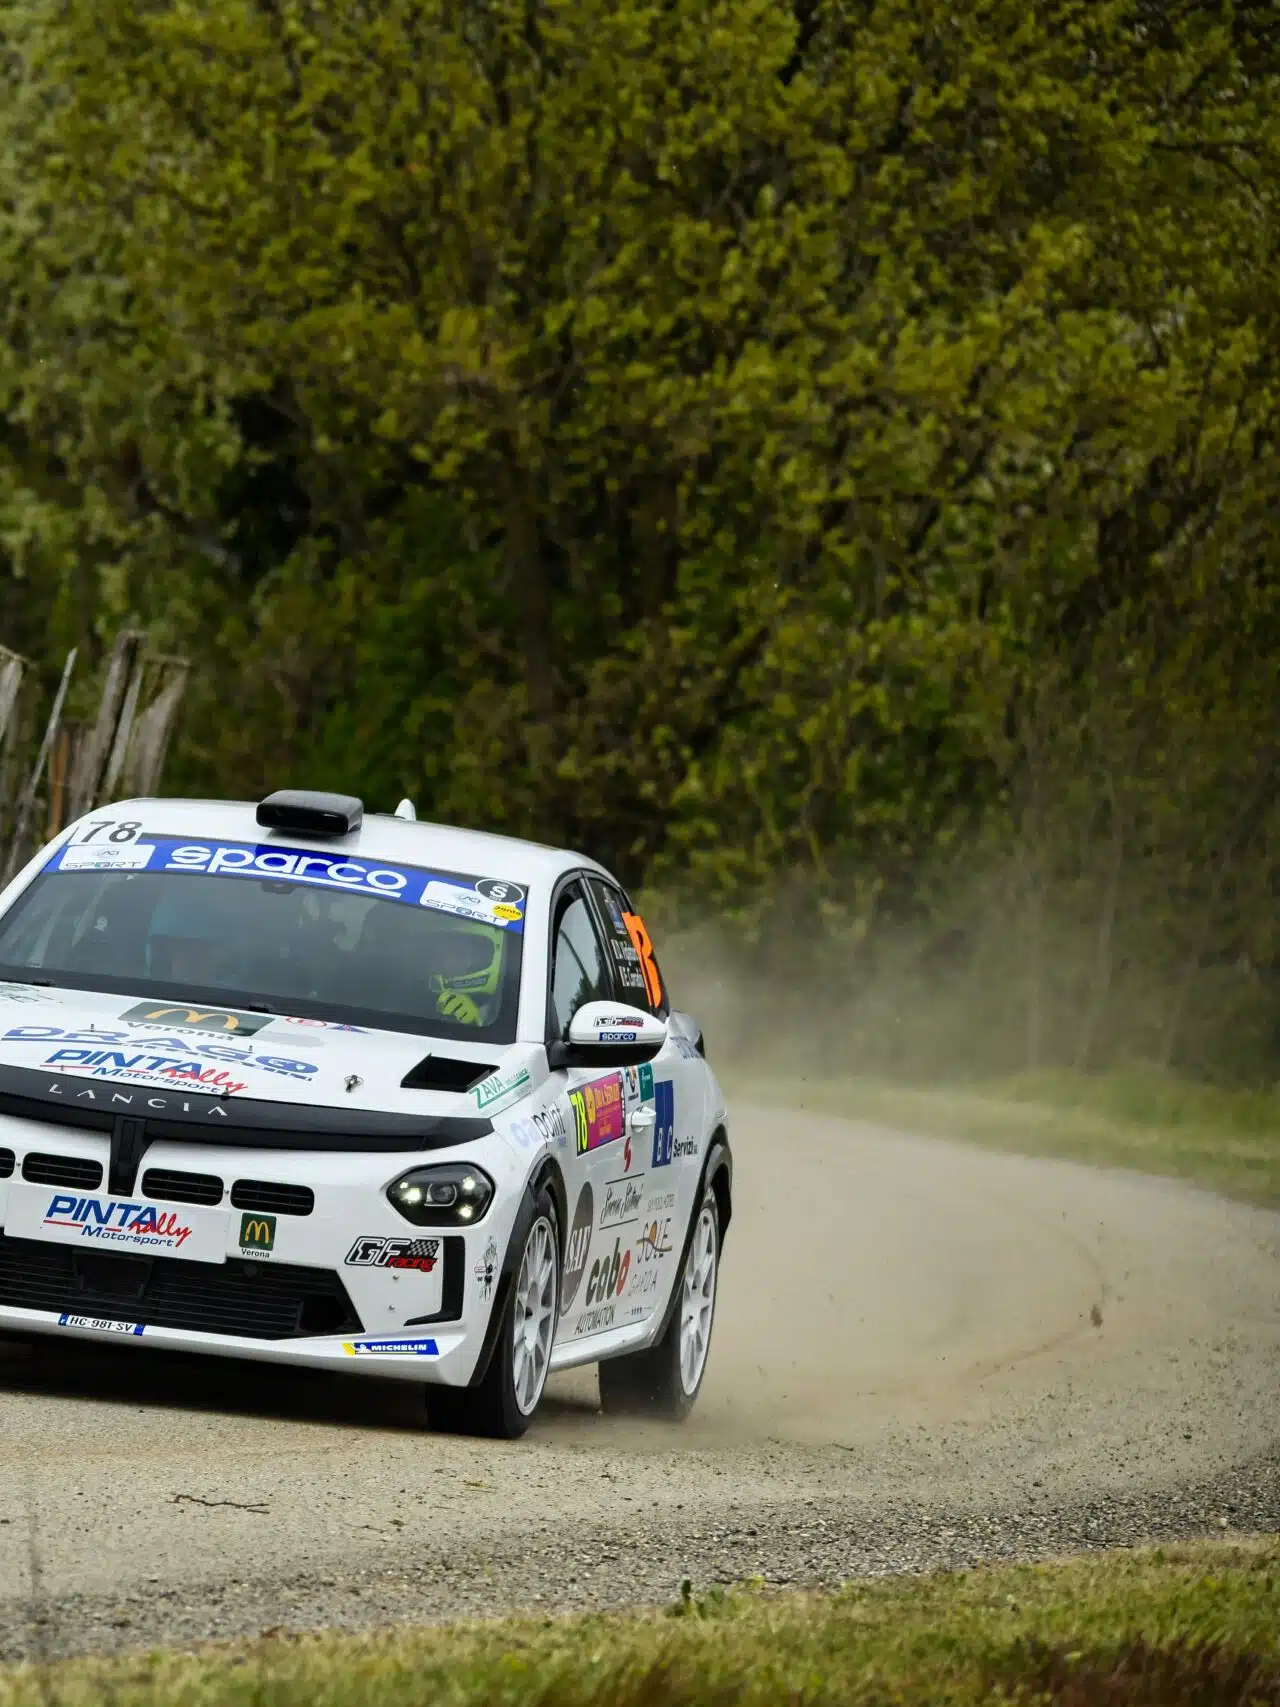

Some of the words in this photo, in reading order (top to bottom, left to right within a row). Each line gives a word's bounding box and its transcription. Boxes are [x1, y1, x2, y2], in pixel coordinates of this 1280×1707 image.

[81, 821, 143, 843] 78
[65, 861, 142, 869] SPORT
[171, 845, 408, 892] sparco
[126, 1021, 234, 1041] Verona
[602, 1032, 634, 1041] sparco
[45, 1049, 203, 1079] PINTA
[91, 1067, 222, 1094] Motorsport
[163, 1067, 248, 1095] rally
[48, 1084, 228, 1117] LANCIA
[570, 1091, 588, 1152] 78
[45, 1194, 158, 1230] PINTA
[81, 1224, 174, 1247] Motorsport
[128, 1212, 192, 1248] rally
[637, 1217, 671, 1264] SOLE
[241, 1248, 270, 1259] Verona
[344, 1236, 412, 1267] GF
[387, 1257, 437, 1273] racing
[70, 1316, 133, 1332] HC-981-SV
[574, 1304, 617, 1336] AUTOMATION
[371, 1343, 428, 1352] MICHELIN
